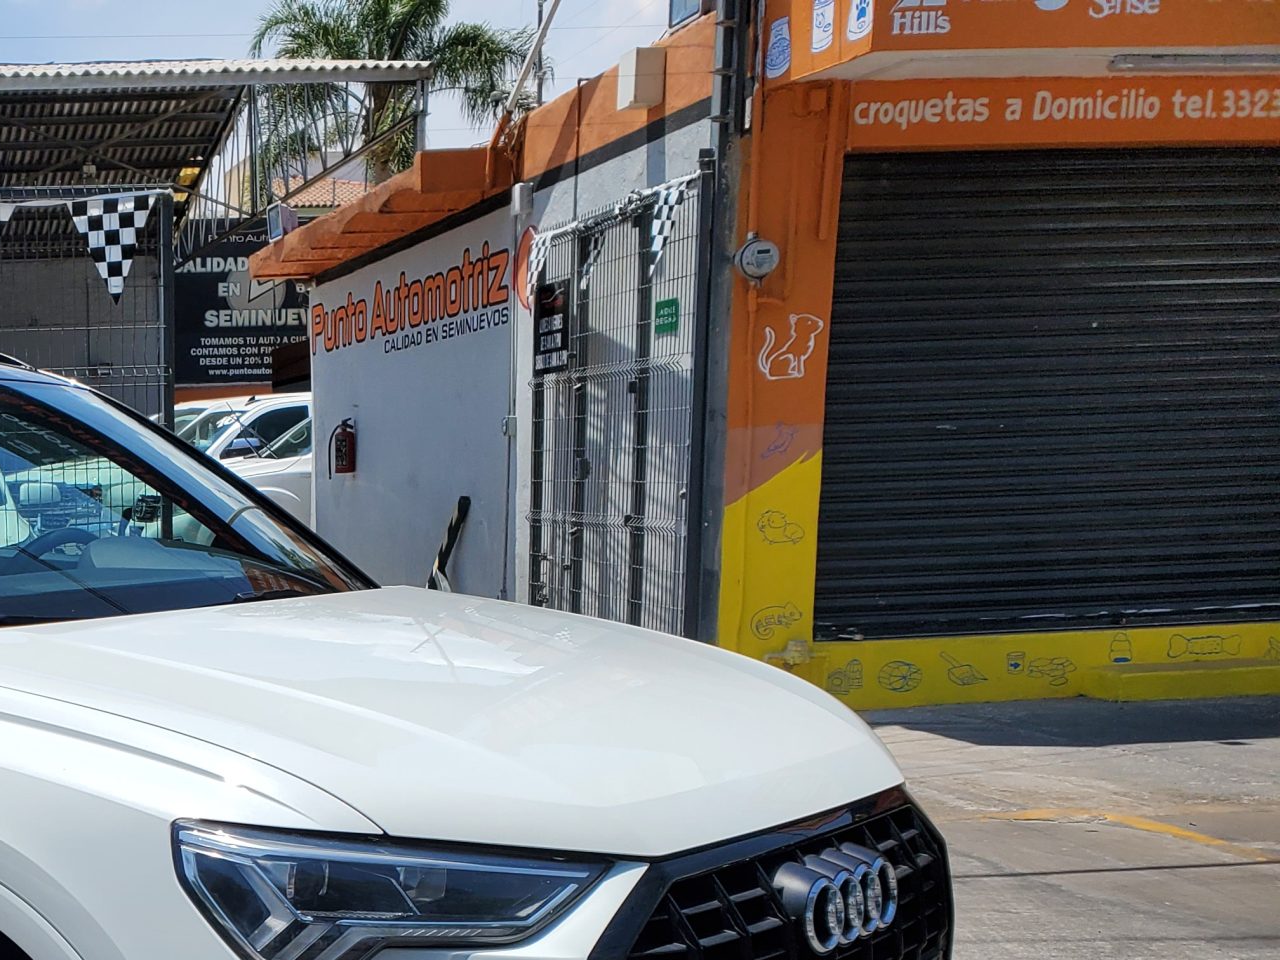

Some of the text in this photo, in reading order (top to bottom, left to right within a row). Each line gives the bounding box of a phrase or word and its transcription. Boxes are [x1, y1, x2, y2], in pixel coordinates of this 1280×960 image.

[891, 11, 952, 35] Hill's
[854, 91, 990, 130] croquetas
[1004, 98, 1022, 121] a
[1032, 88, 1161, 121] Domicilio
[218, 282, 241, 297] EN
[311, 240, 510, 356] Punto Automotriz
[384, 307, 509, 354] CALIDAD EN SEMINUEVOS
[200, 337, 244, 345] TOMAMOS
[246, 337, 256, 345] TU
[190, 347, 238, 356] CONTAMOS
[239, 346, 259, 354] CON
[200, 357, 228, 366] DESDE
[230, 357, 242, 365] UN
[244, 356, 261, 365] 20%
